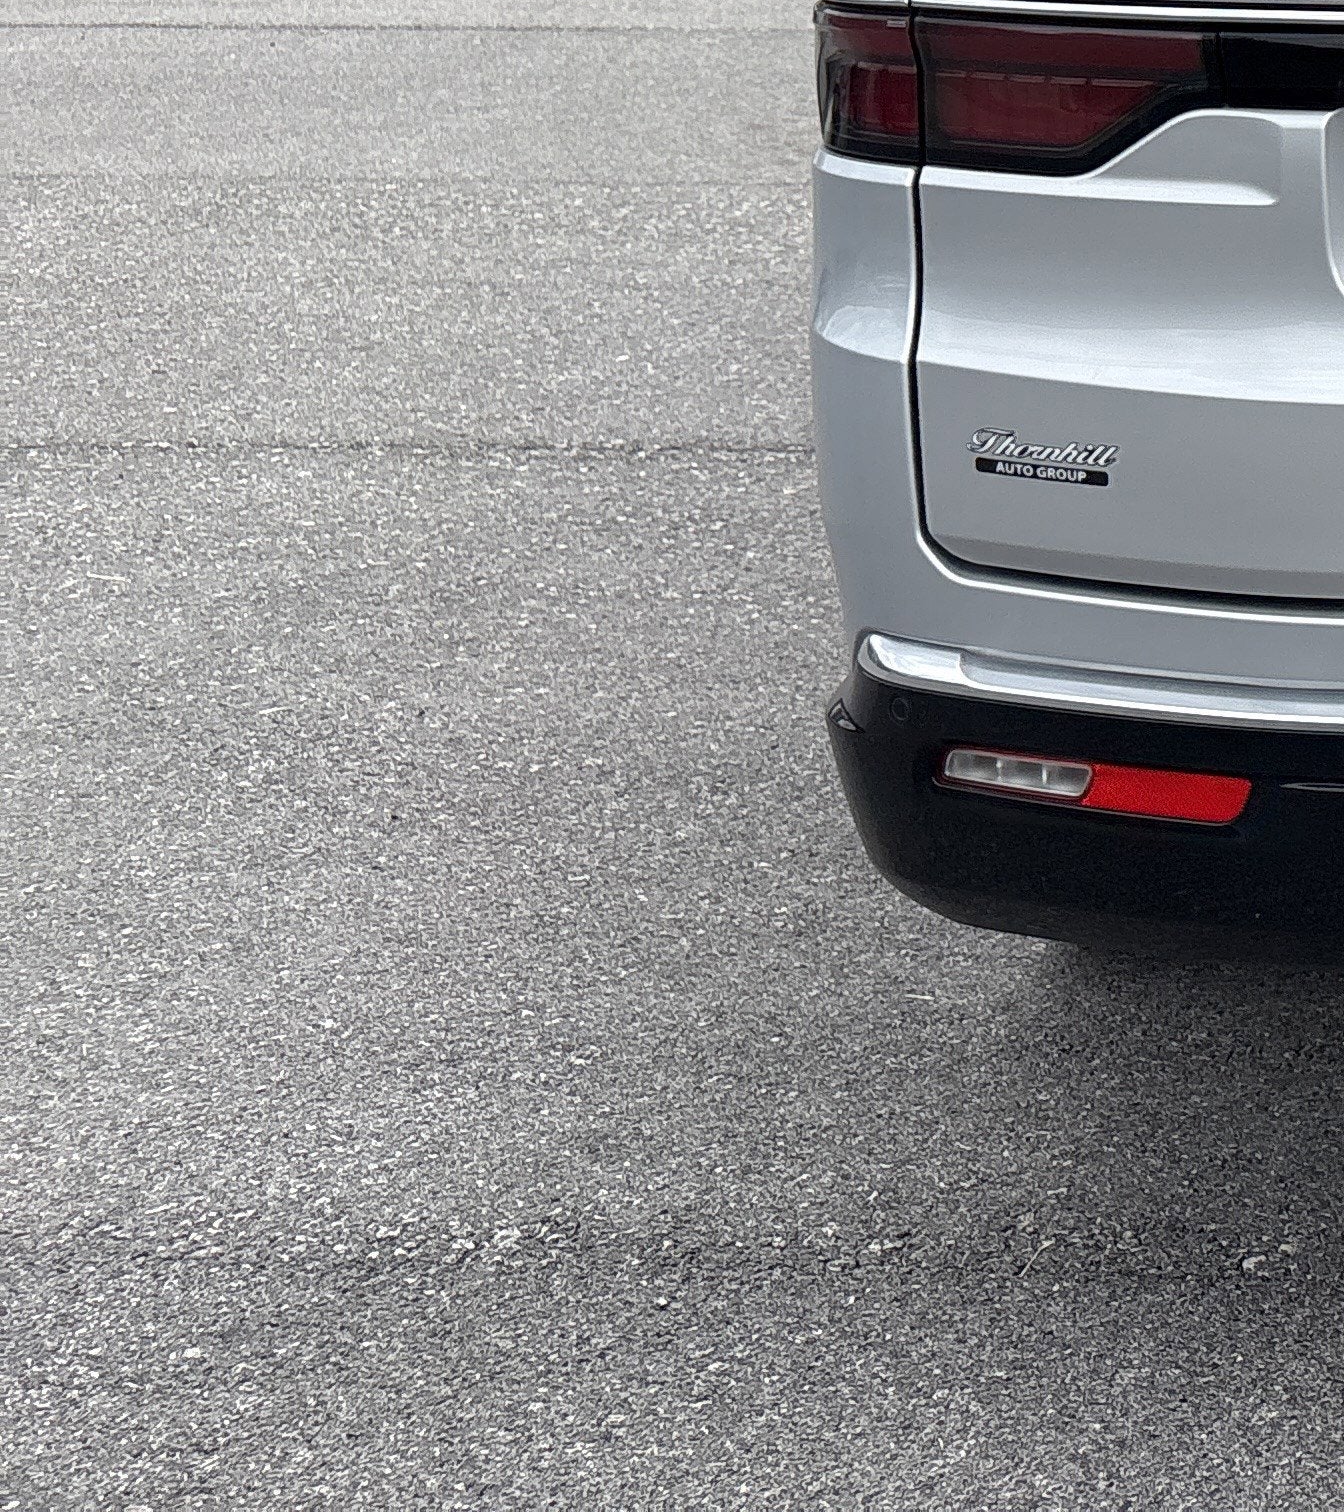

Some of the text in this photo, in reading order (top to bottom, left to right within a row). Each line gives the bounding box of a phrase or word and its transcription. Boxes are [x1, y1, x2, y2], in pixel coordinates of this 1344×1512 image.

[966, 426, 1119, 467] Thornhill
[995, 461, 1087, 482] AUTO GROUP
